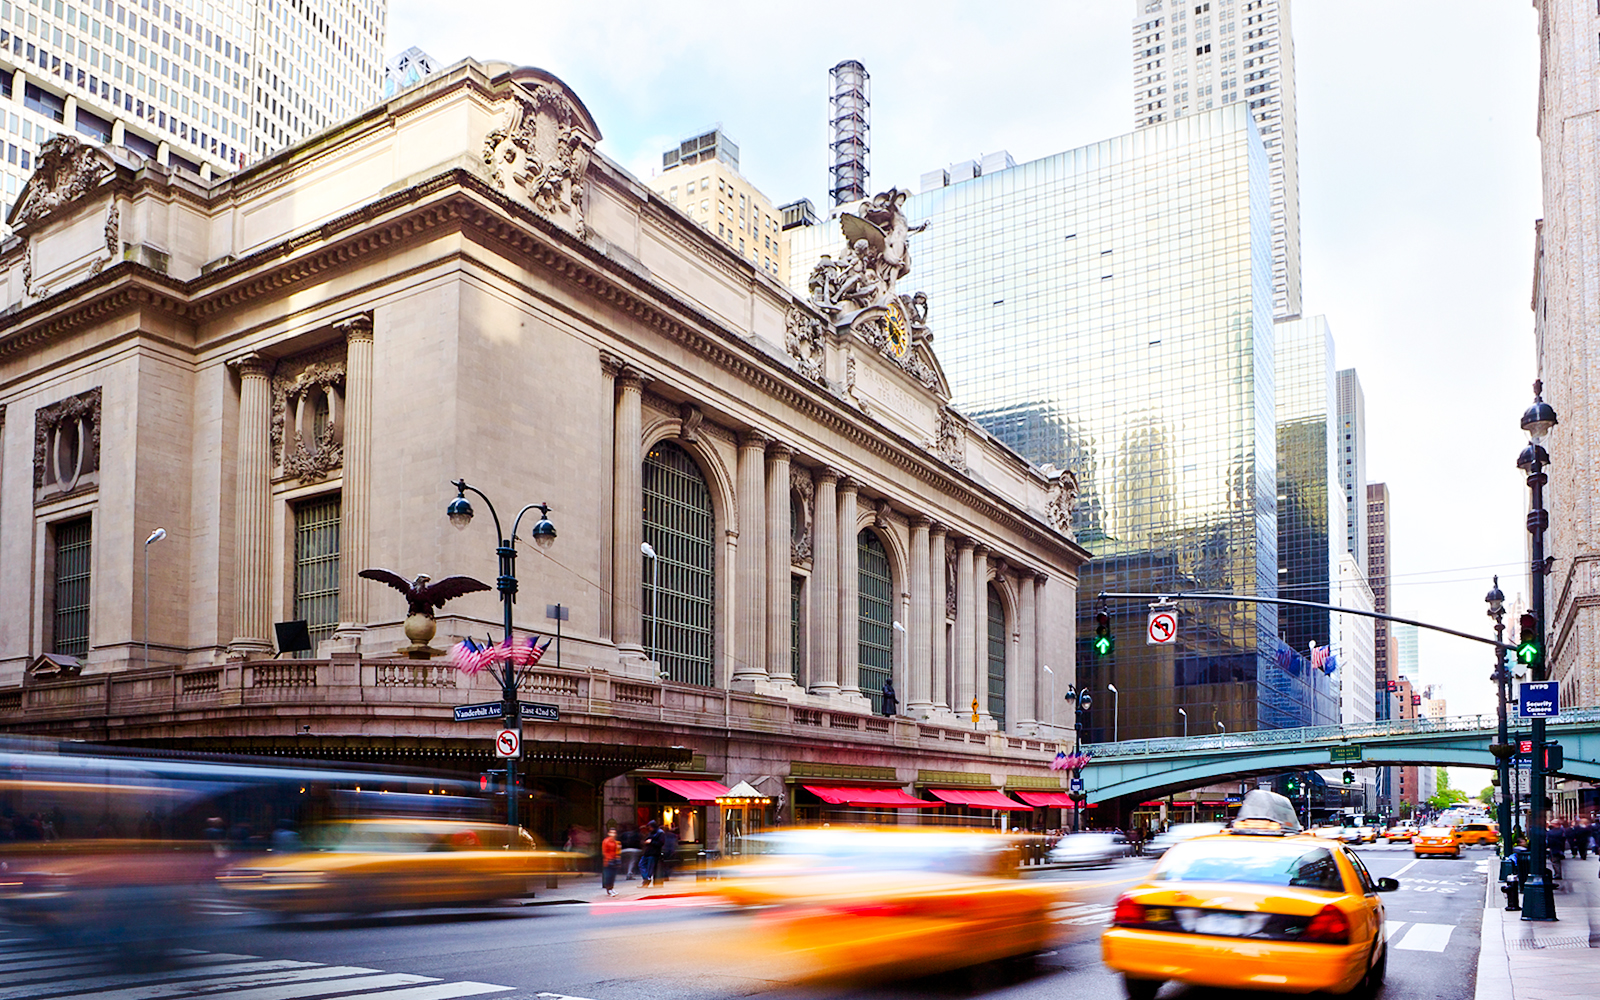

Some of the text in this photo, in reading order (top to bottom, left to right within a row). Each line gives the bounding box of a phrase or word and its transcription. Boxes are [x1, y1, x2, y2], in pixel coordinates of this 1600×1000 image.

[863, 366, 926, 416] GRAND CENTRAL
[455, 706, 501, 718] Vanderbilt Ave
[520, 705, 557, 717] East 42nd St
